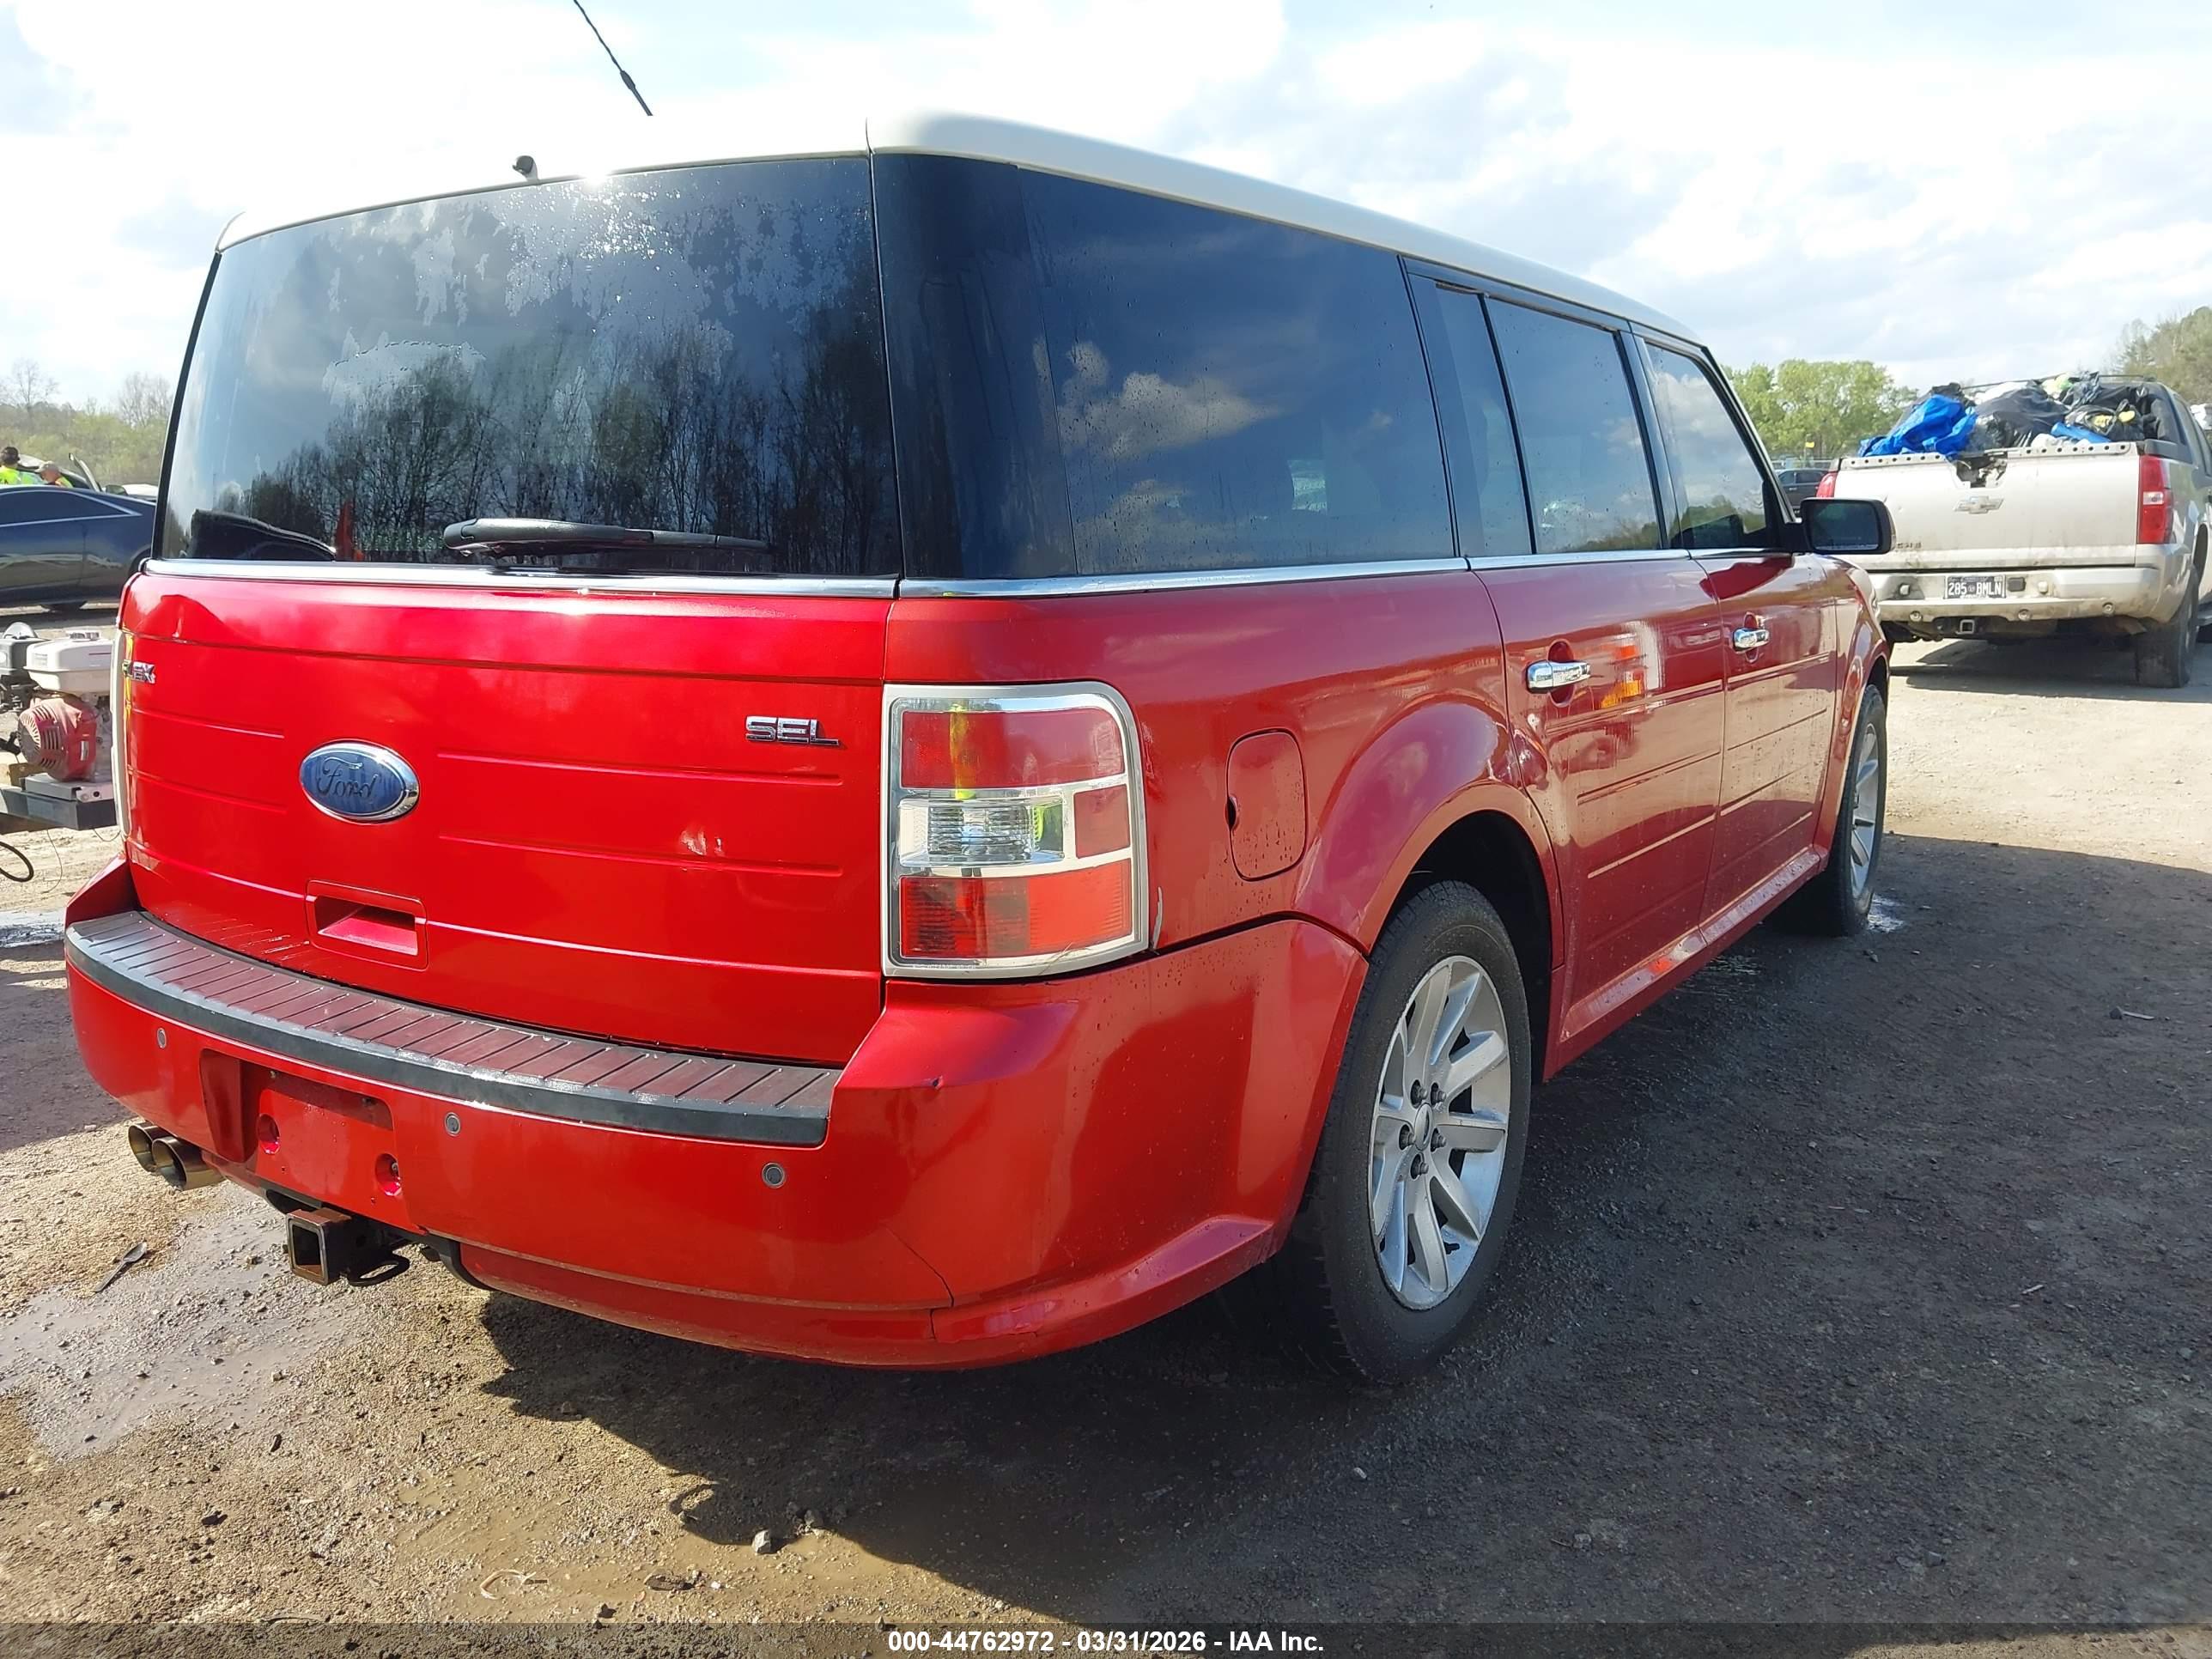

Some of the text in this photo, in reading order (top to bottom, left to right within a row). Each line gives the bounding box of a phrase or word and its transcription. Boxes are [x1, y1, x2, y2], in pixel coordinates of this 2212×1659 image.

[1948, 581, 2002, 596] 285 BMLN
[745, 715, 839, 746] SEL
[315, 756, 379, 798] Ford
